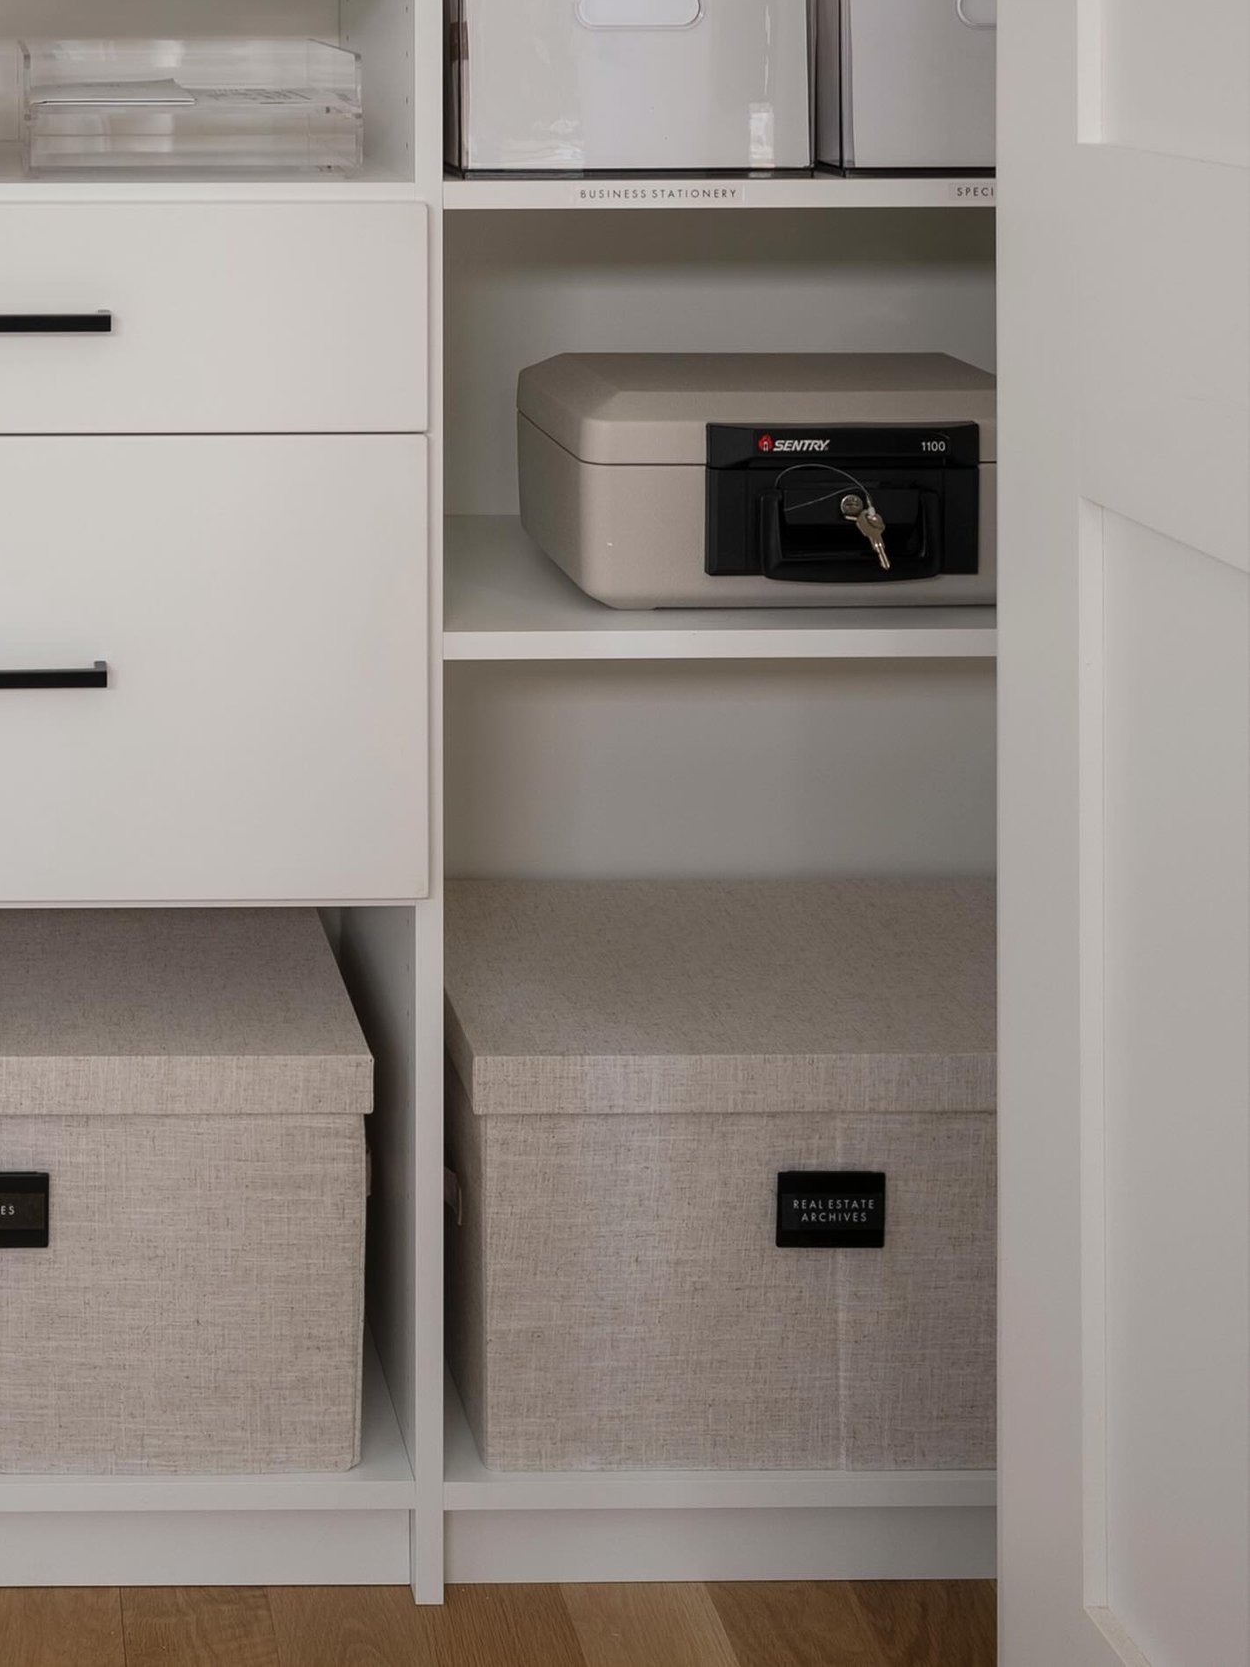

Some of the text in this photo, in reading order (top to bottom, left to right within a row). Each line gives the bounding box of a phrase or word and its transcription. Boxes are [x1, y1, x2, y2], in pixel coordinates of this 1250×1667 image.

[581, 188, 737, 199] BUSINESS STATIONERY
[956, 186, 994, 197] SPECI
[773, 439, 829, 452] SENTRY
[921, 441, 946, 452] 1100
[793, 1199, 874, 1210] REAL ESTATE
[801, 1212, 867, 1223] ARCHIVES
